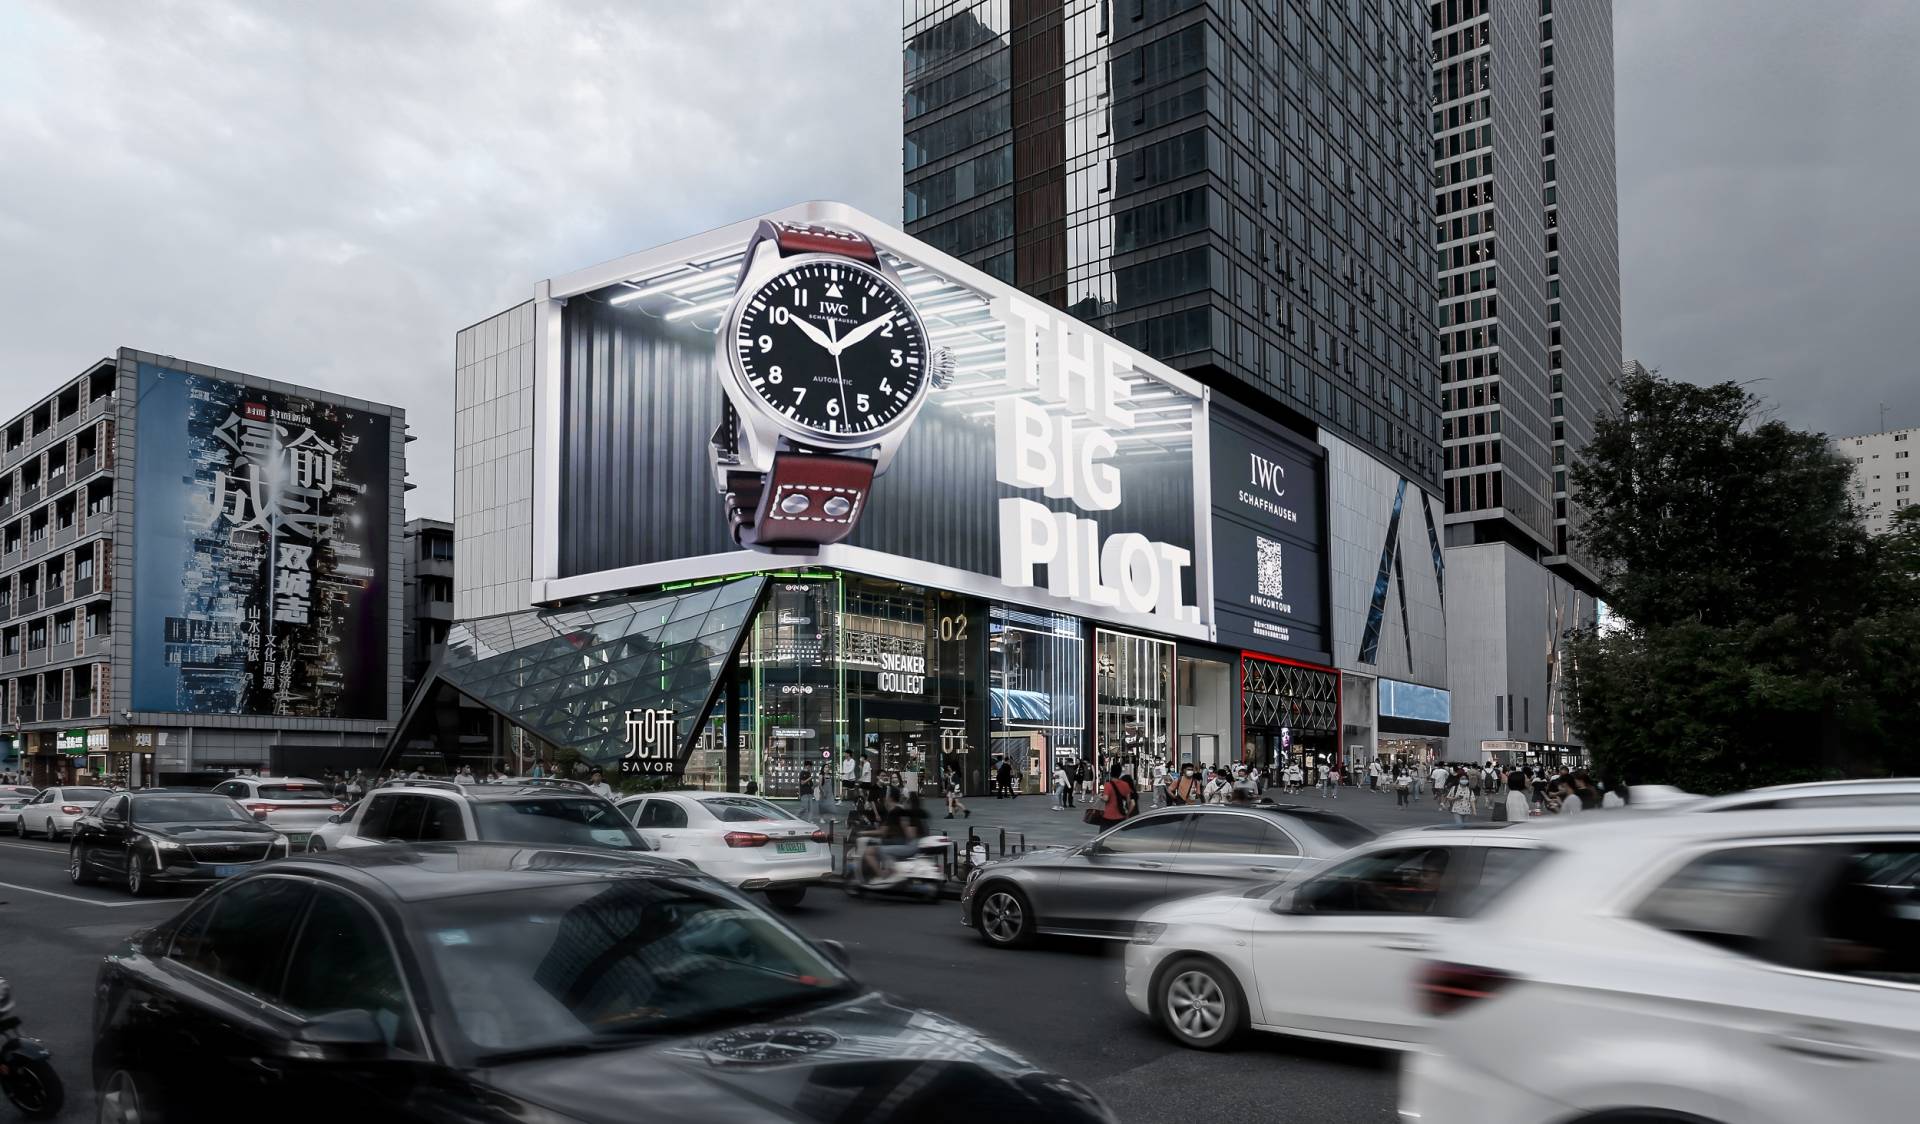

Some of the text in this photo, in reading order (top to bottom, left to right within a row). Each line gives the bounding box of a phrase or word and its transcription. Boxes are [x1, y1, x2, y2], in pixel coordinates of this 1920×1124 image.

[769, 306, 789, 325] 10
[819, 301, 848, 316] IWC
[880, 319, 894, 338] 2
[758, 334, 773, 353] 9
[889, 349, 903, 368] 3
[992, 295, 1136, 430] THE
[768, 365, 783, 384] 8
[813, 375, 853, 386] AUTOMATIC
[792, 387, 807, 405] 7
[879, 377, 892, 396] 4
[826, 398, 840, 417] 6
[856, 393, 870, 412] 5
[996, 397, 1122, 511] BIG
[1250, 453, 1285, 497] IWC
[1238, 490, 1297, 523] SCHAFFHAUSEN
[999, 497, 1201, 626] PILOT.
[248, 605, 261, 662] 山水相依
[940, 613, 968, 643] 02
[263, 634, 278, 690] 文化同源
[880, 652, 925, 674] SNEAKER
[878, 673, 925, 695] COLLECT
[624, 708, 675, 759] 玩味
[622, 761, 673, 773] SAVOR
